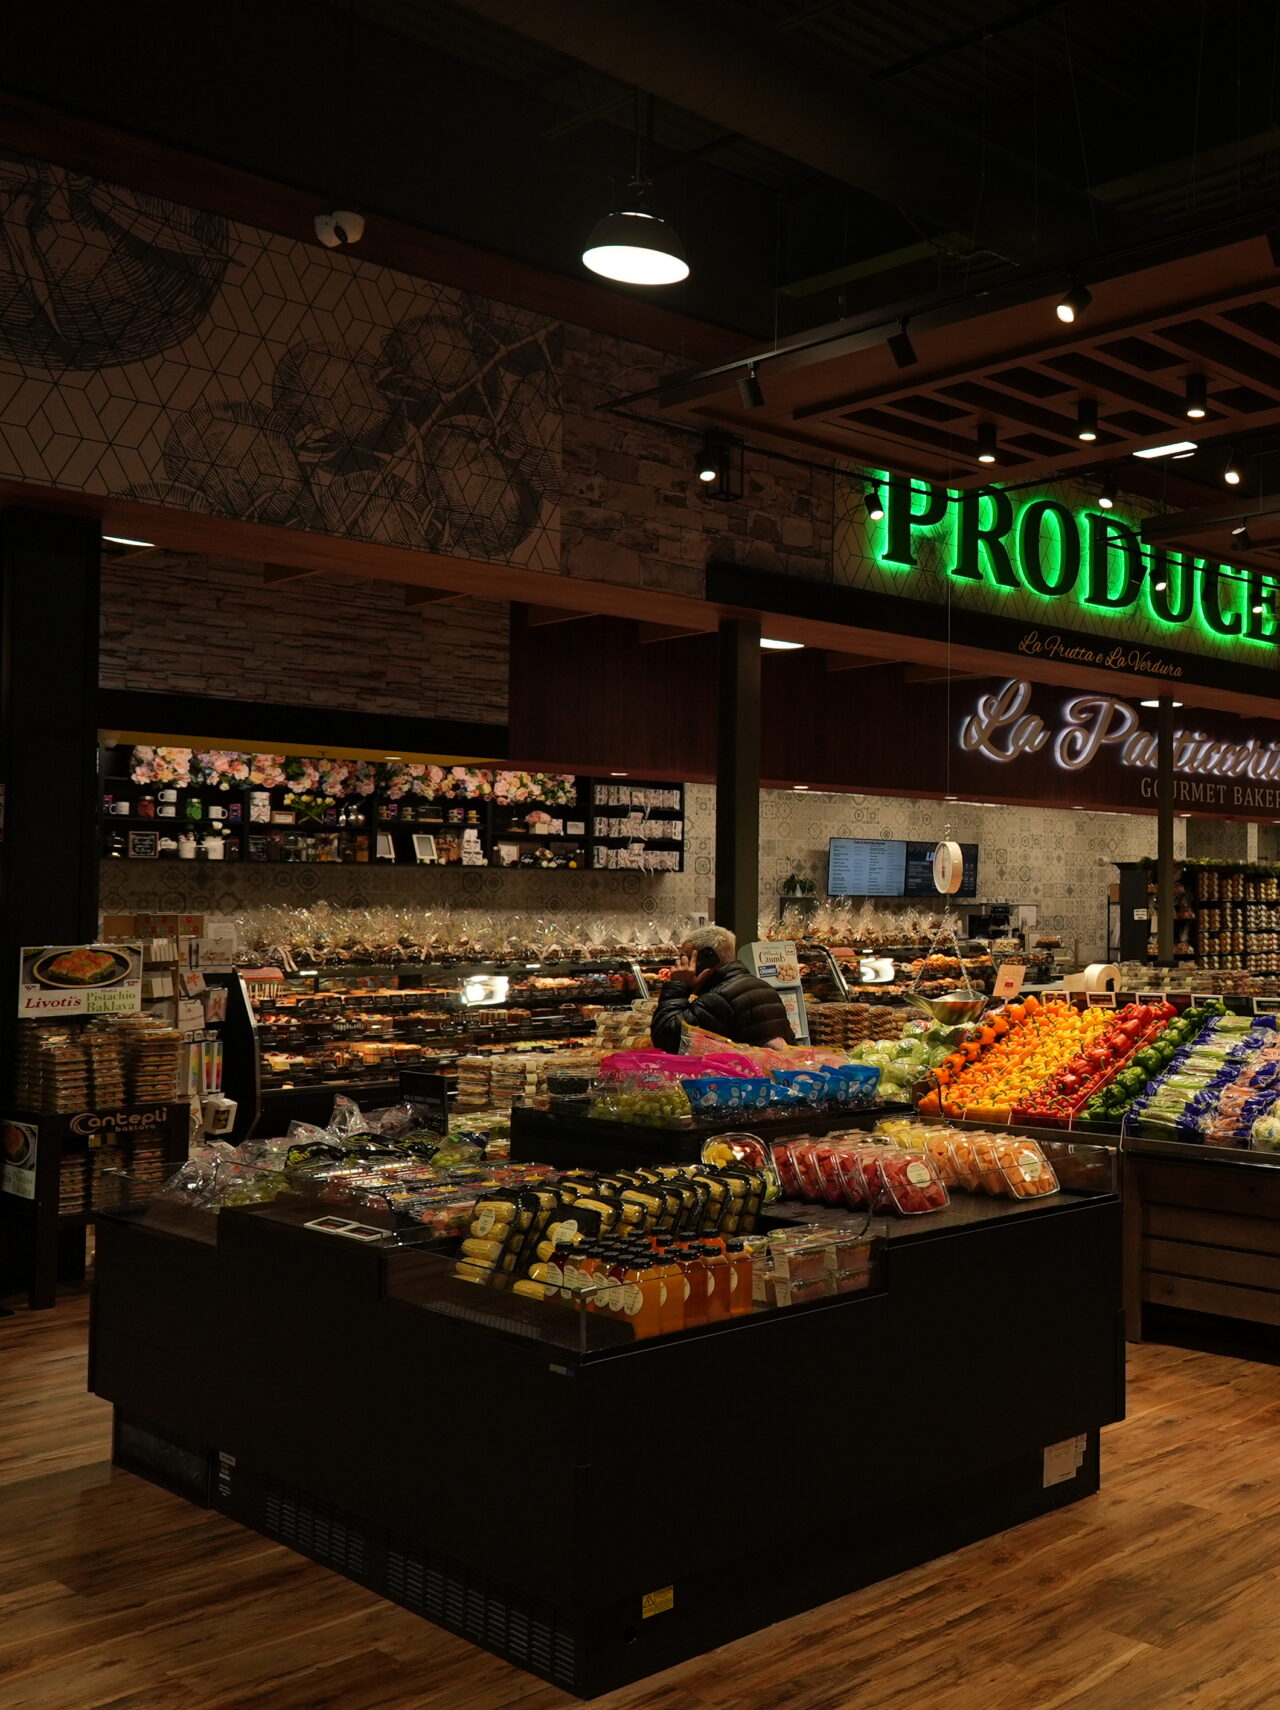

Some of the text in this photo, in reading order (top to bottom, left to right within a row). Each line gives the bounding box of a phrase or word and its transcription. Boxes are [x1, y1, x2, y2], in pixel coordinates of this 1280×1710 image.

[1018, 630, 1043, 655] La
[1044, 634, 1094, 662] Frutta
[1105, 646, 1127, 669] La
[1127, 650, 1184, 678] Verdura
[960, 678, 1050, 763] La
[87, 990, 136, 1001] Pistachio
[87, 1001, 135, 1013] Baklava
